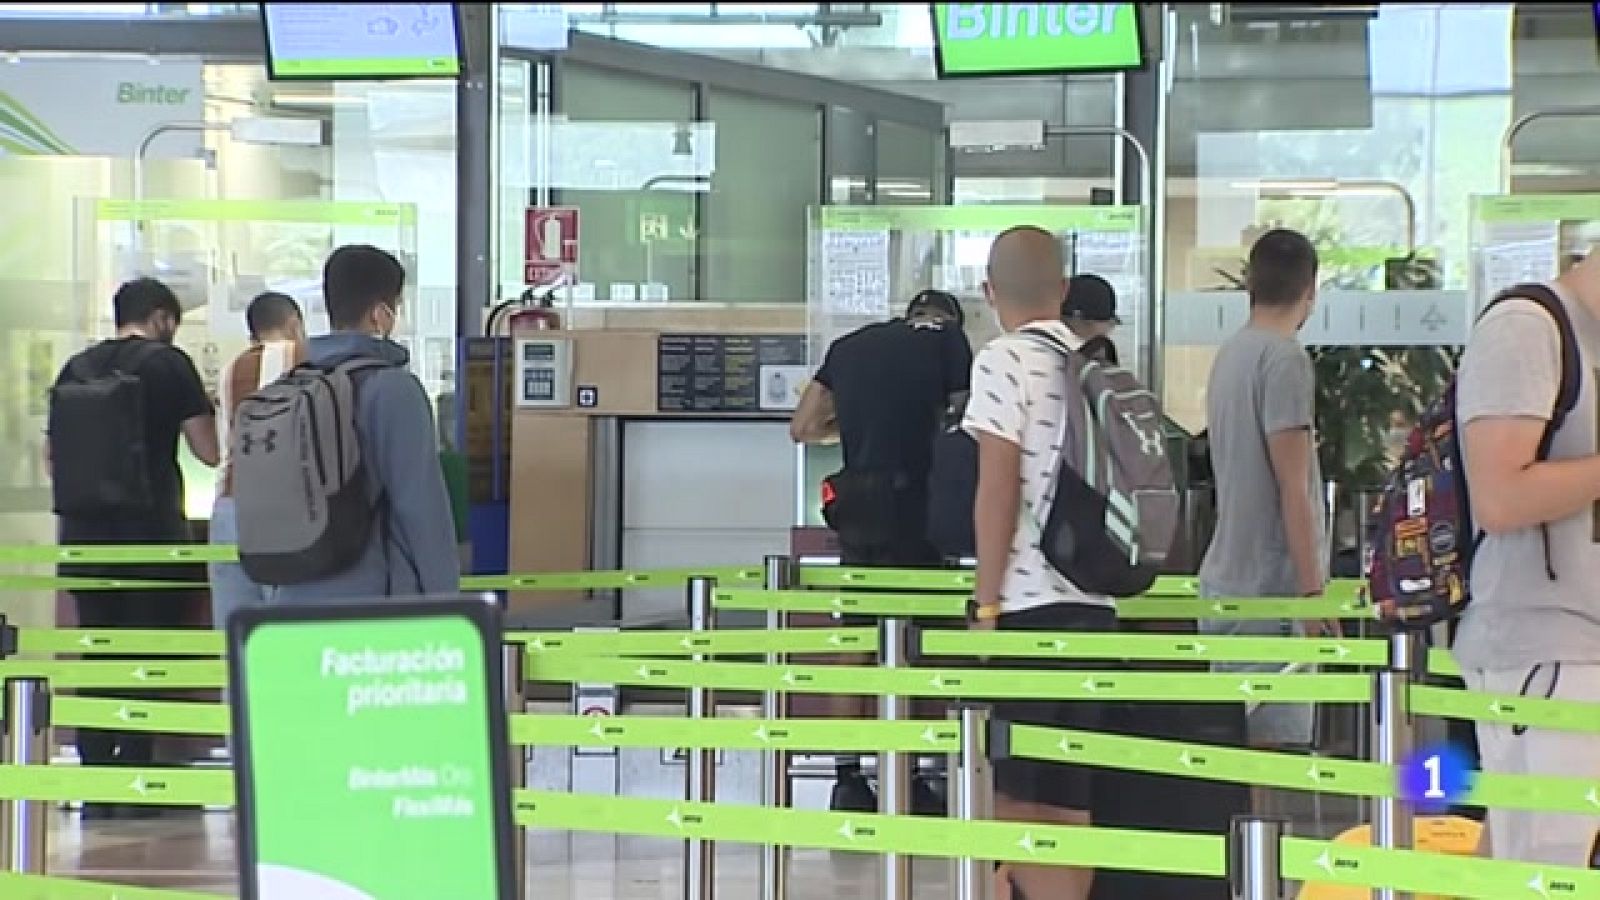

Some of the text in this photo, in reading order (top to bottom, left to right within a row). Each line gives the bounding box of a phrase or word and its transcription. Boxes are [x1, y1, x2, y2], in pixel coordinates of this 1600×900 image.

[947, 3, 1122, 40] Binter
[117, 81, 191, 105] Binter
[321, 643, 465, 679] Facturación
[347, 677, 466, 715] prioritaria
